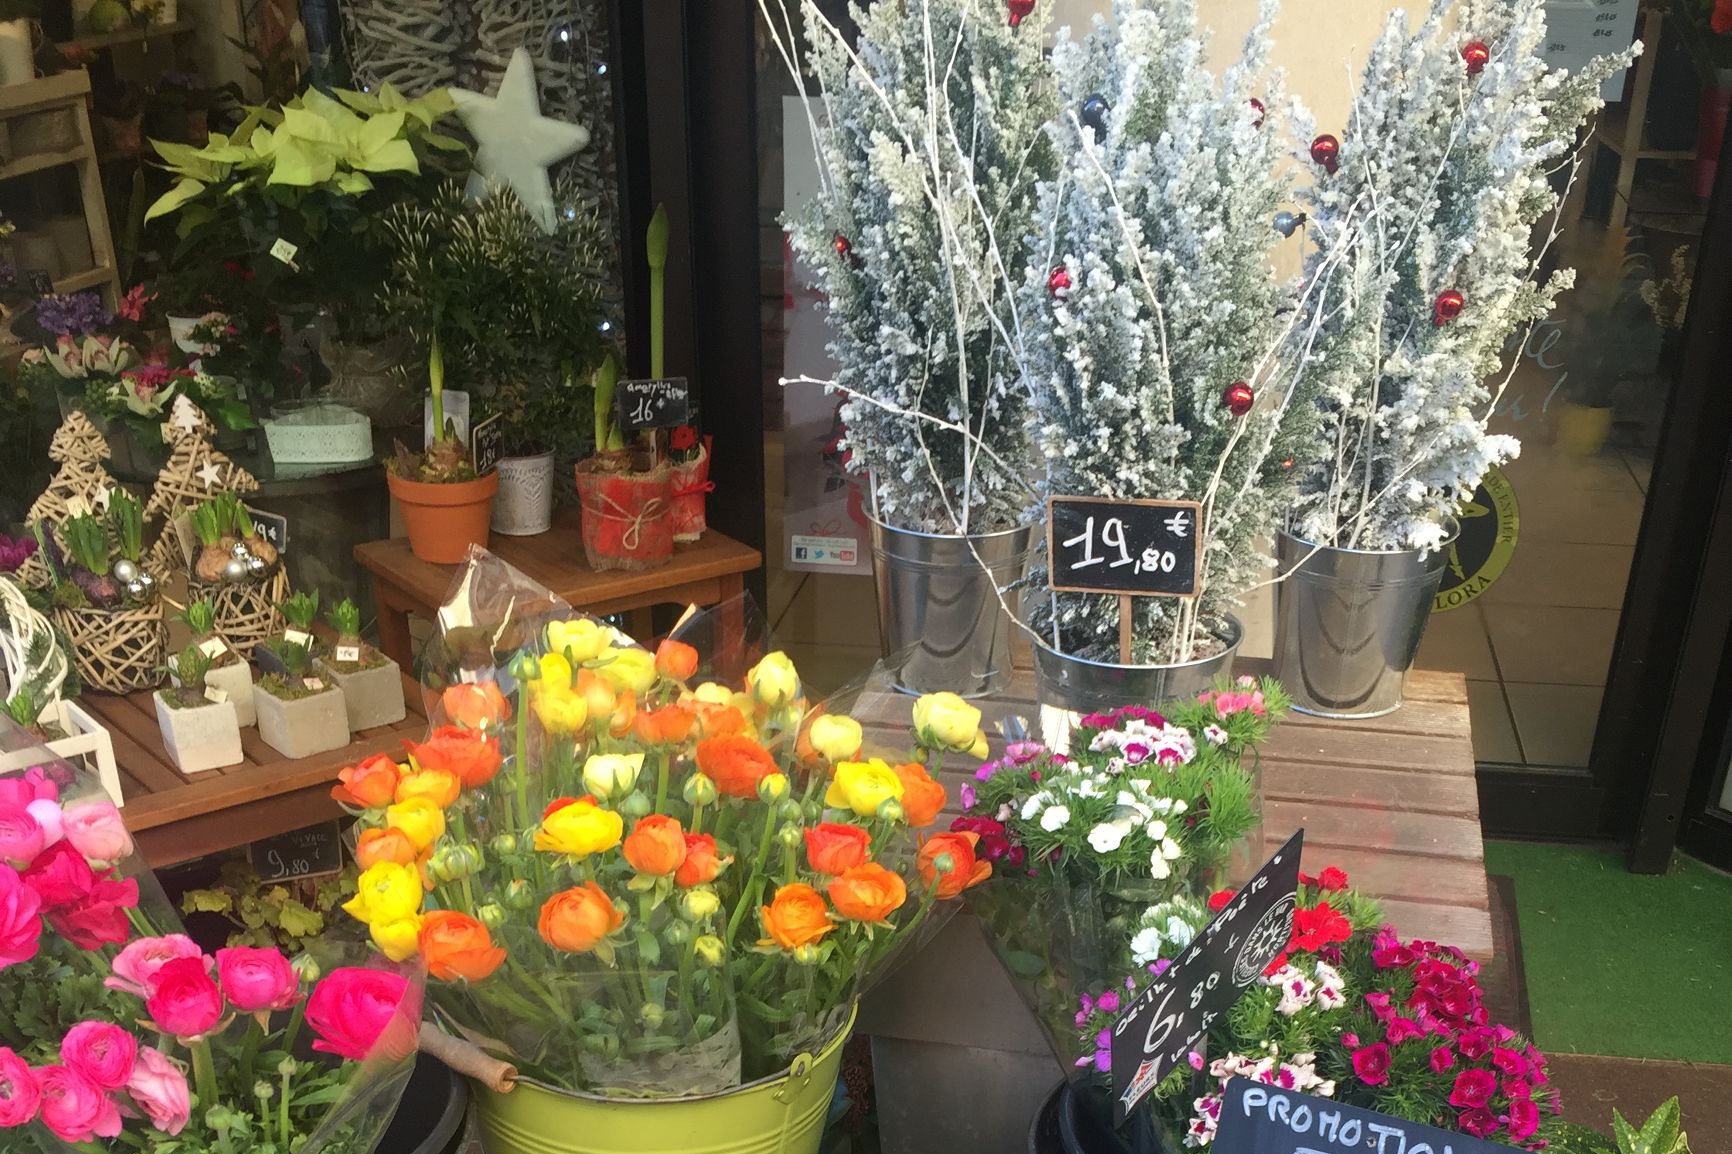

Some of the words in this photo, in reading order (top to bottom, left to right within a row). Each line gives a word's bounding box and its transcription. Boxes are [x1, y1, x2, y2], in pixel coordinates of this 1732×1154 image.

[630, 397, 653, 424] 16
[1063, 516, 1176, 575] 19,80
[1163, 511, 1190, 537] €
[1435, 575, 1492, 610] LORA
[268, 849, 309, 878] 9,80
[1143, 971, 1220, 1053] 6,80
